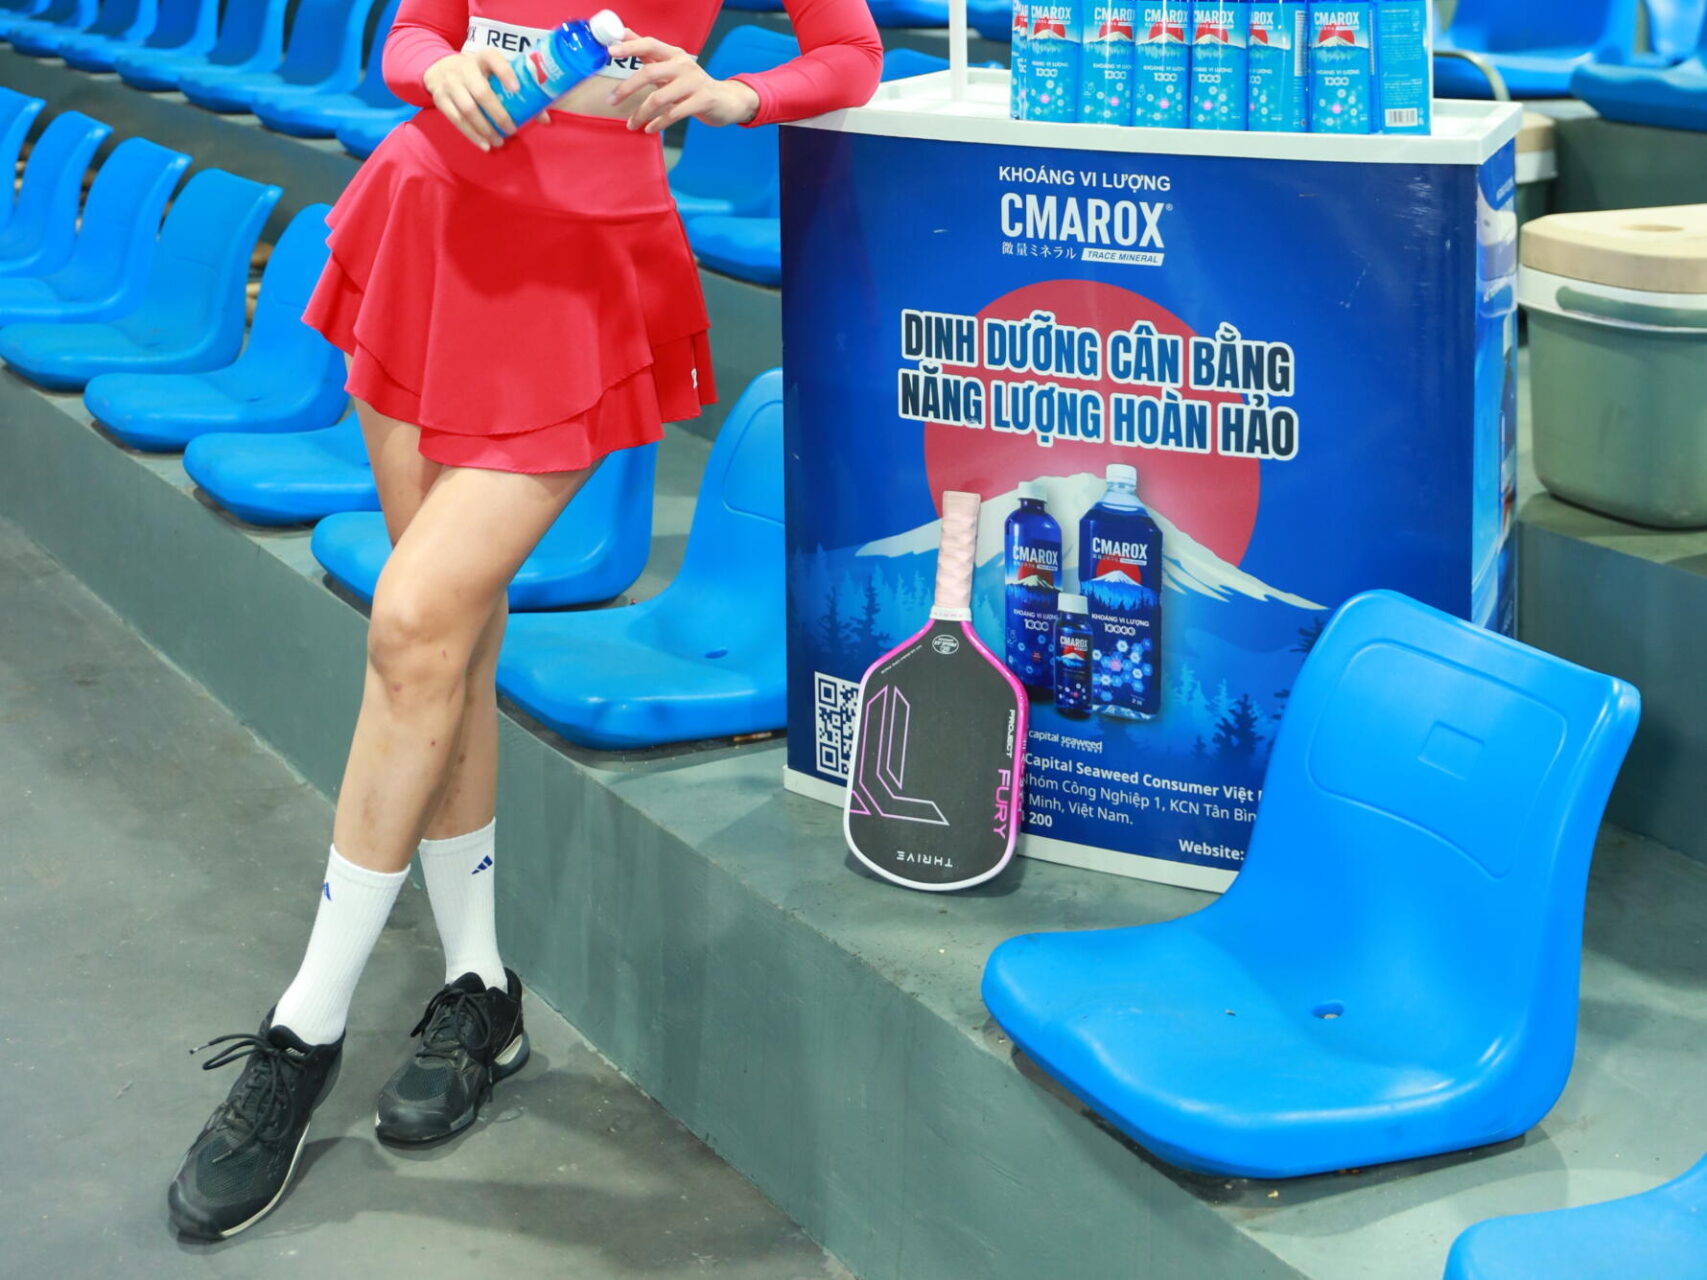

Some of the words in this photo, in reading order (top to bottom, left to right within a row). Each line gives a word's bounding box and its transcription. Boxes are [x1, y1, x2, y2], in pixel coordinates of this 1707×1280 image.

[1313, 11, 1360, 26] CMAROX
[998, 165, 1075, 186] KHOÁNG
[1079, 171, 1097, 187] VI
[1102, 172, 1171, 193] LƯỢNG
[1000, 192, 1165, 249] CMAROX
[1086, 250, 1117, 261] TRACE
[1118, 253, 1159, 264] MINERAL
[986, 311, 1101, 378] DƯỠNG
[1109, 321, 1181, 385] CÂN
[1192, 323, 1292, 393] BẰNG
[900, 361, 985, 426] NĂNG
[992, 381, 1103, 445] LƯỢNG
[1112, 387, 1210, 451] HOÀN
[1220, 394, 1297, 459] HẢO
[1012, 545, 1059, 567] CMAROX
[1092, 536, 1148, 560] CMAROX
[1024, 618, 1050, 632] 1000
[1028, 730, 1060, 742] capital
[1025, 752, 1073, 773] Capital
[1076, 761, 1139, 785] Seaweed
[1142, 774, 1219, 800] Consumer
[1222, 785, 1255, 804] Việt
[993, 768, 1012, 840] FURY
[1029, 793, 1065, 814] Minh,
[1068, 801, 1095, 819] Việt
[1097, 808, 1134, 825] Nam.
[1062, 779, 1096, 802] Công
[1100, 785, 1150, 811] Nghiệp
[1154, 796, 1166, 812] 1,
[1170, 799, 1200, 816] KCN
[1203, 803, 1230, 820] Tân
[1234, 807, 1258, 823] Bìn
[1029, 812, 1053, 828] 200
[896, 850, 953, 868] THRIVE
[1178, 838, 1245, 862] Website:
